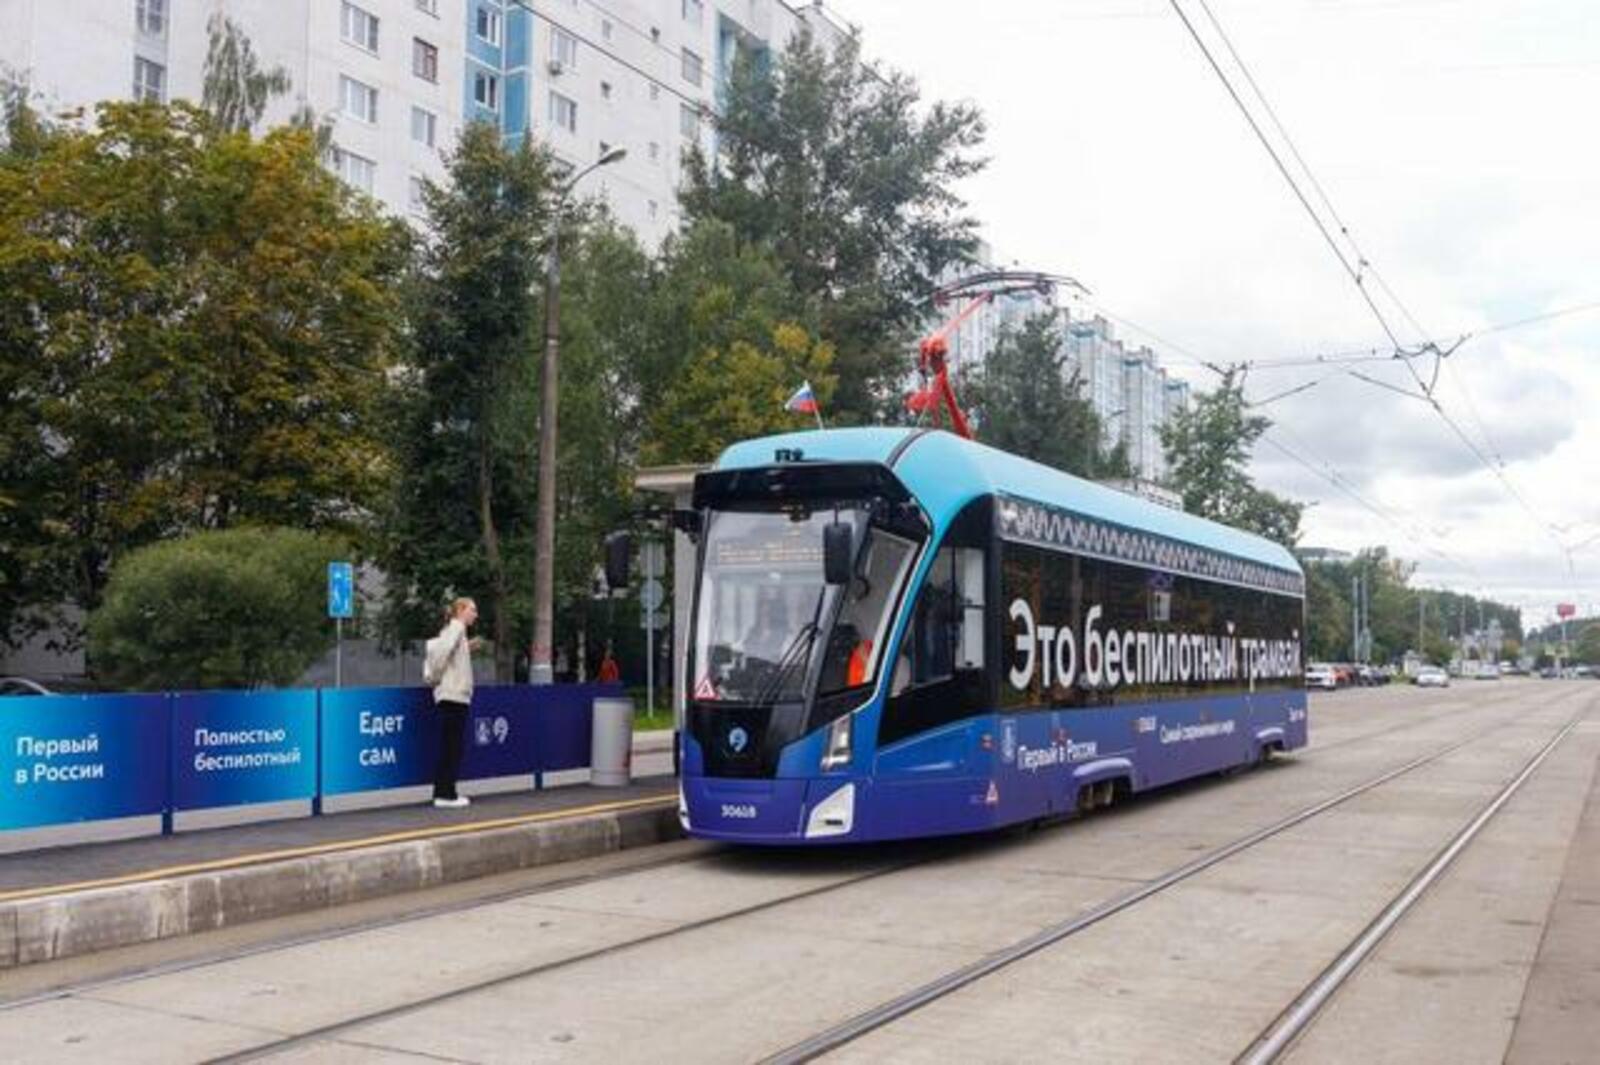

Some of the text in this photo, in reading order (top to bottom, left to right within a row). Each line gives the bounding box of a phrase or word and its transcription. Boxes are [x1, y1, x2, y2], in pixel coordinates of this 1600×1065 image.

[1009, 599, 1076, 689] Это
[1084, 604, 1237, 685] беспилотный
[359, 711, 404, 734] Едет
[16, 733, 99, 758] Первый
[194, 728, 286, 747] Полностью
[194, 746, 301, 771] беспилотный
[359, 748, 396, 766] сам
[15, 762, 104, 784] в России
